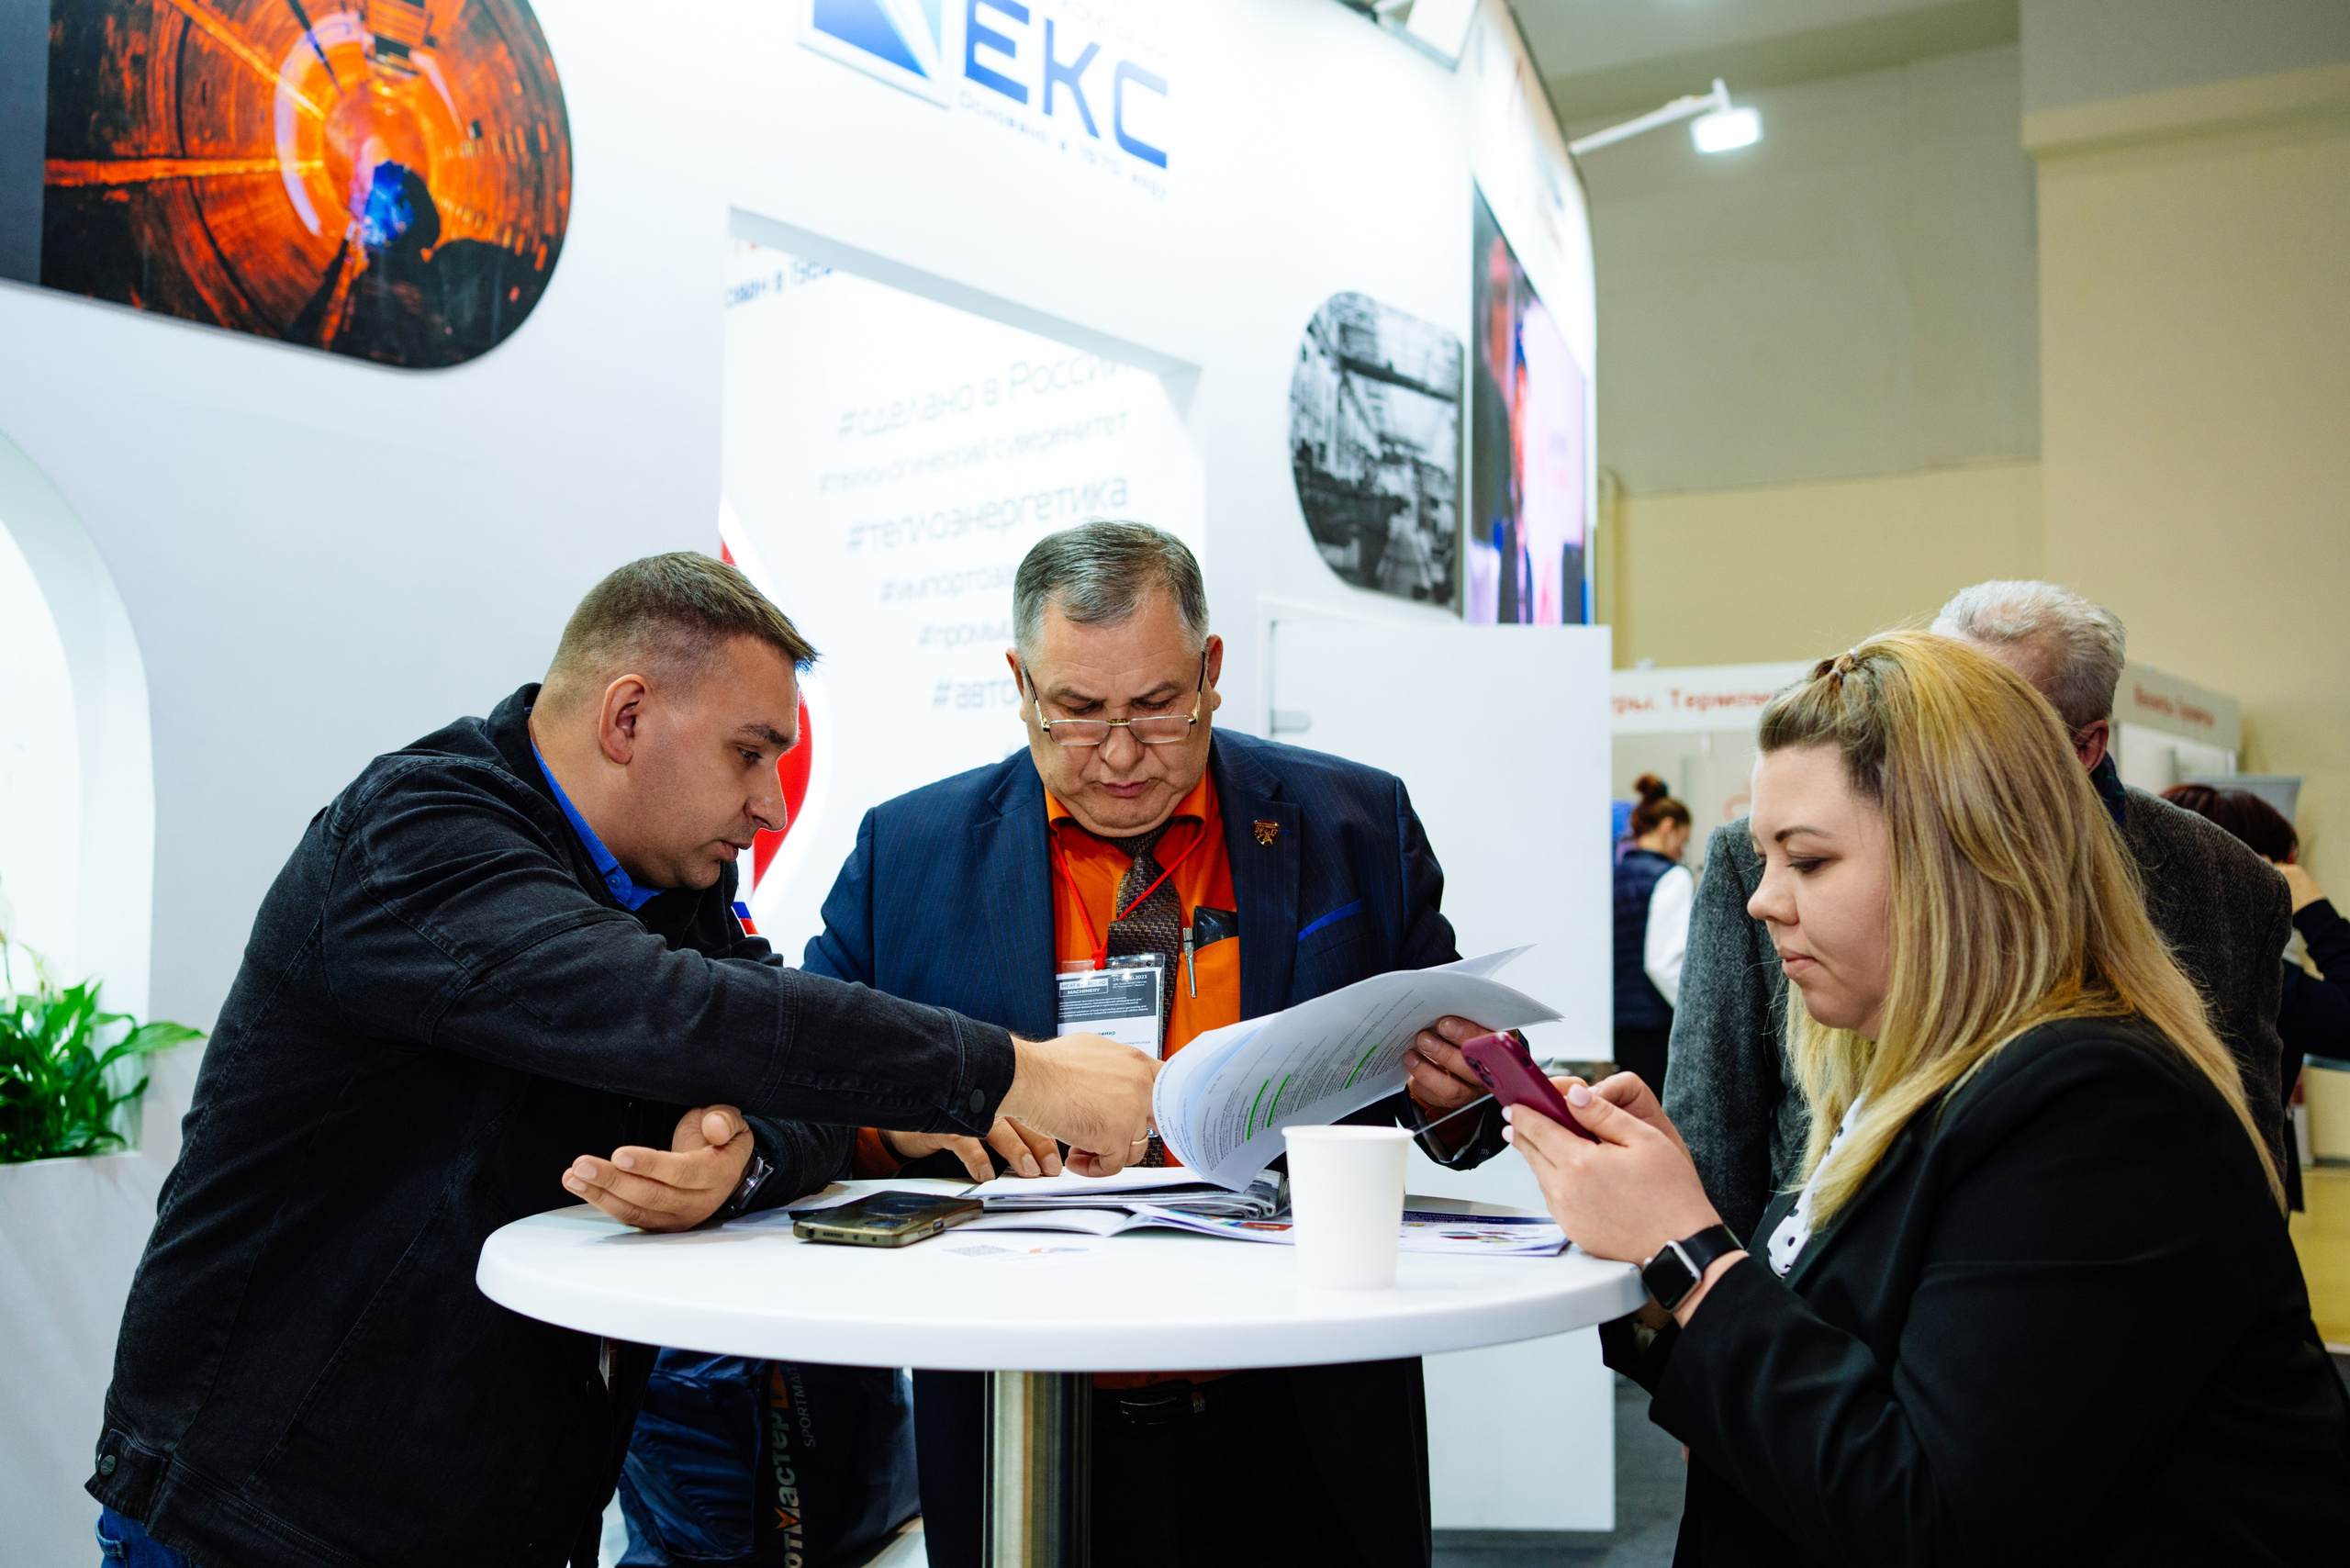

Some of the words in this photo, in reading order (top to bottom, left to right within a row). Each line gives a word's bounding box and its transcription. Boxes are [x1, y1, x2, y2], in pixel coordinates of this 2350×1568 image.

[982, 376, 1001, 408] в
[847, 476, 1128, 553] #теплоэнергетика
[1067, 987, 1101, 995] MACHINERY
